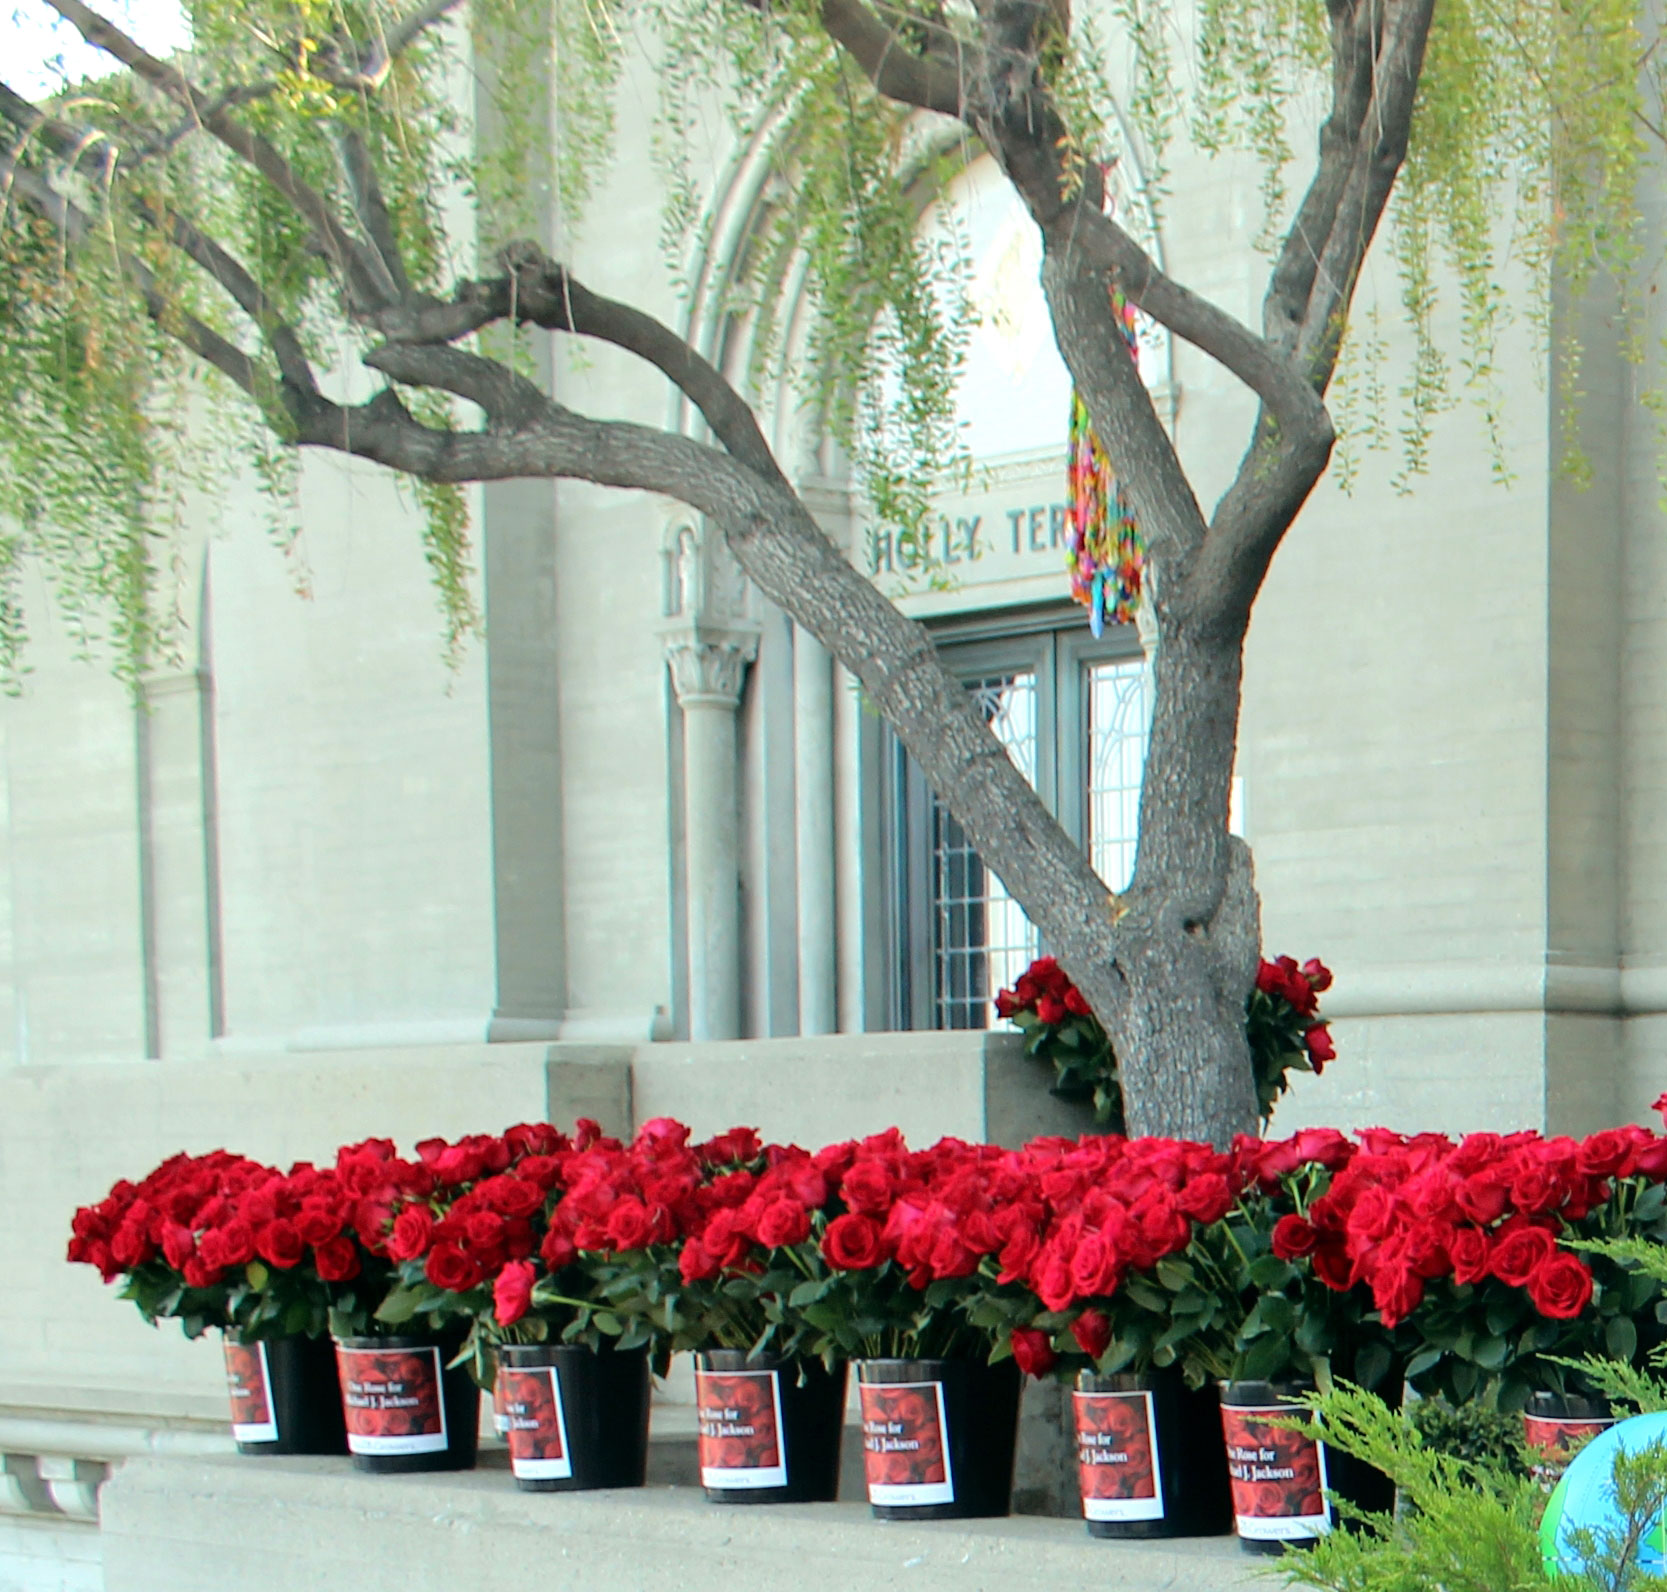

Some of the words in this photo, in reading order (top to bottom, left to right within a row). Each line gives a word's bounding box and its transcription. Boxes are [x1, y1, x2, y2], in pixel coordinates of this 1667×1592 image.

[871, 514, 981, 575] HOLLY
[1006, 503, 1065, 553] TER
[1252, 1465, 1294, 1481] Jackson
